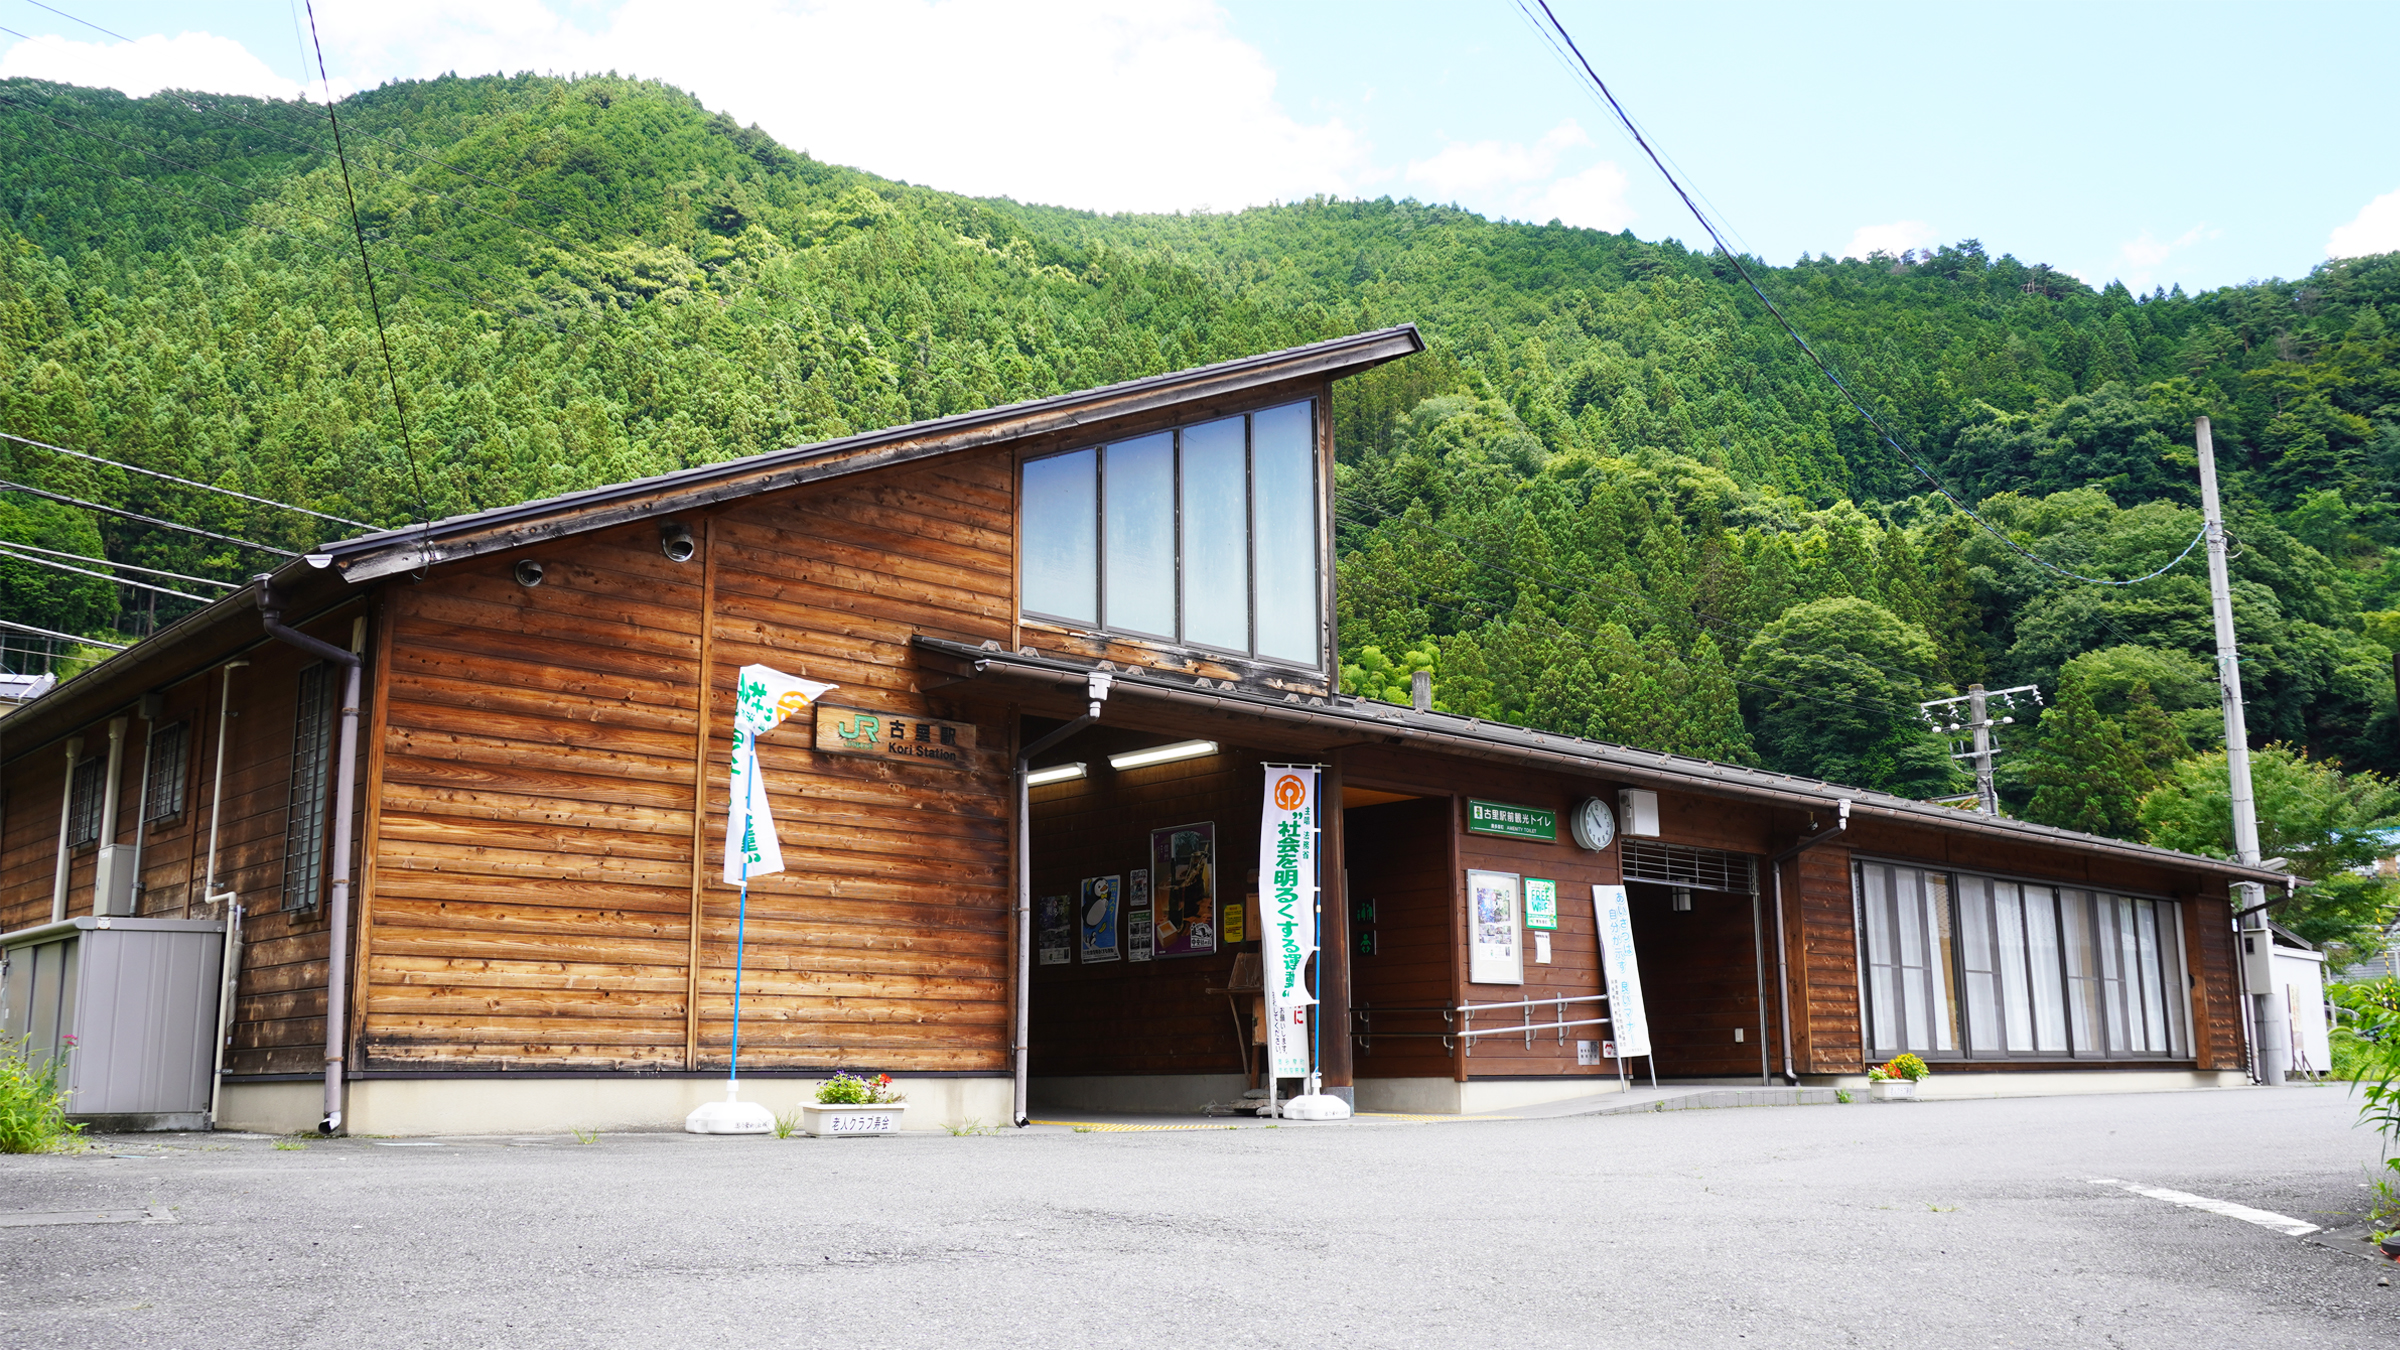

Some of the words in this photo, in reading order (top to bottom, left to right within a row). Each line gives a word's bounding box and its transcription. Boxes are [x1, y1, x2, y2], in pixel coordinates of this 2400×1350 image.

[838, 713, 880, 743] JR
[889, 719, 957, 746] 古里駅
[888, 742, 913, 757] Kori
[916, 745, 956, 762] Station
[1484, 808, 1551, 827] 古里駅前観光トイレ
[1531, 889, 1550, 902] FREE
[1616, 892, 1633, 956] あいさつは
[1609, 909, 1625, 974] 自分が示す
[1621, 981, 1637, 1047] 良いマナー
[831, 1115, 891, 1132] 老人クラブ寿会
